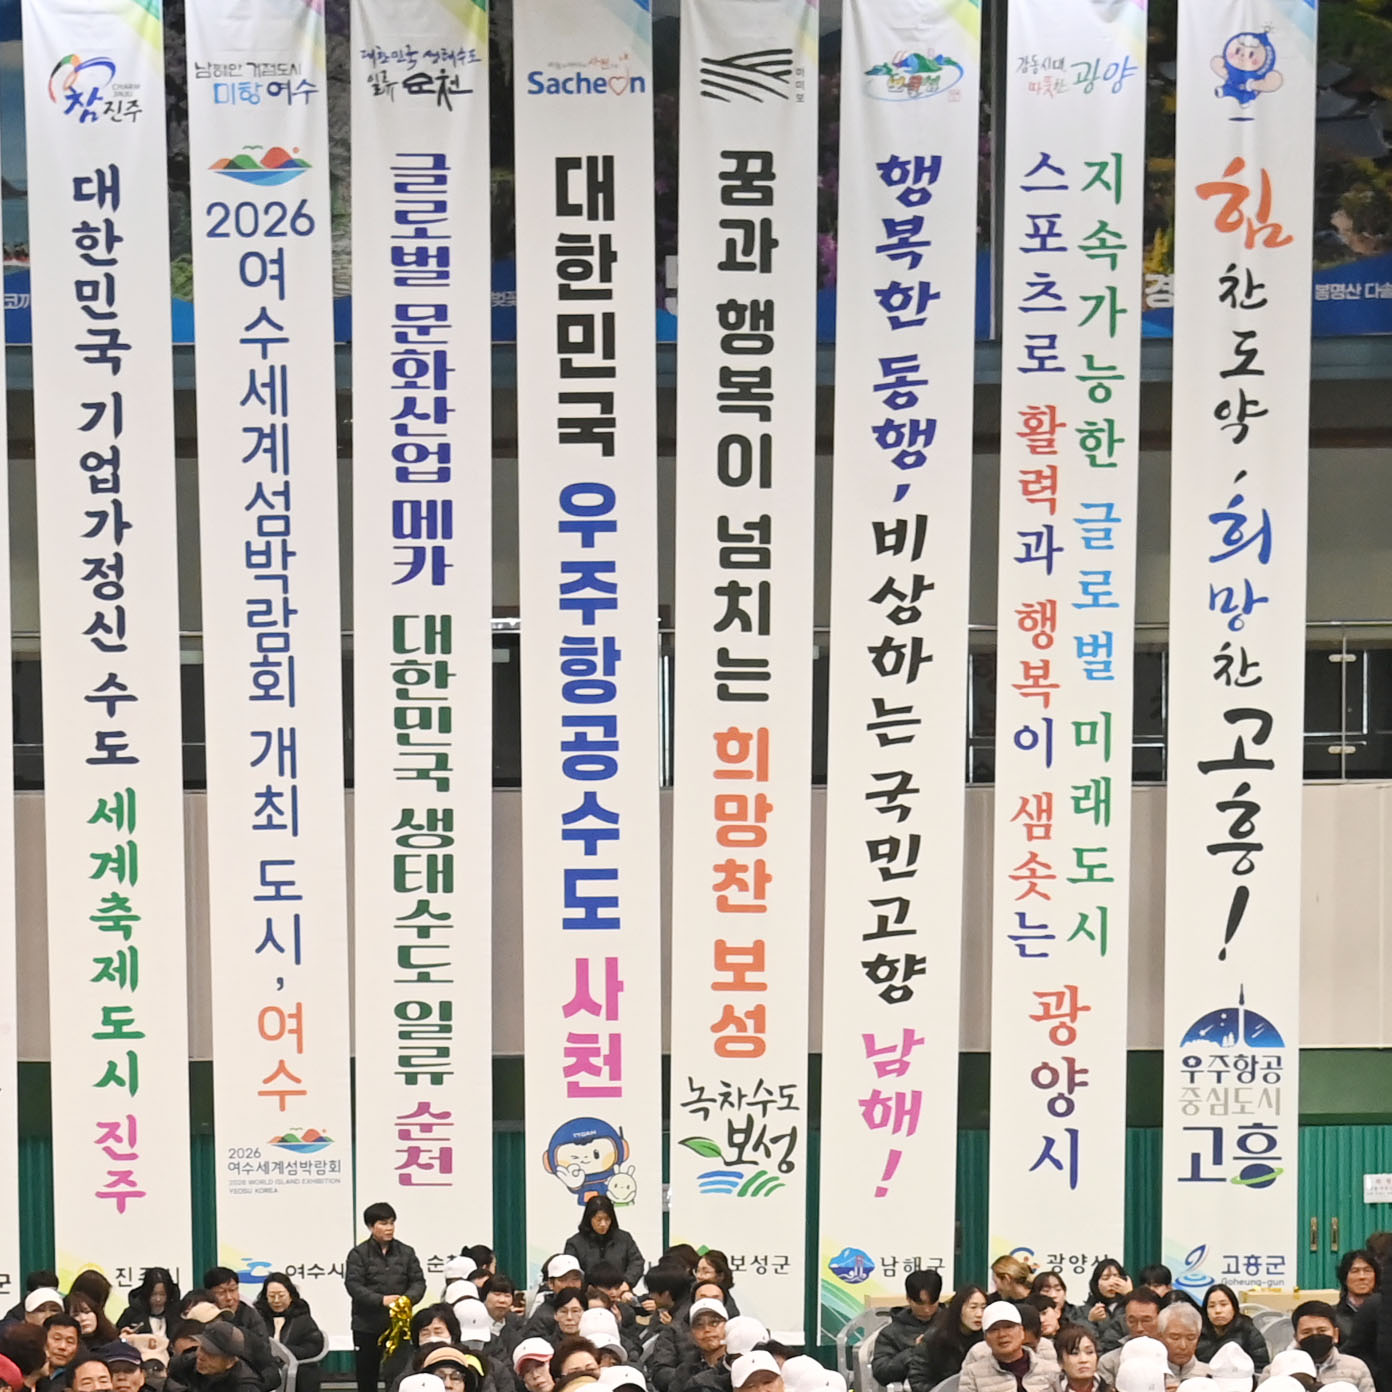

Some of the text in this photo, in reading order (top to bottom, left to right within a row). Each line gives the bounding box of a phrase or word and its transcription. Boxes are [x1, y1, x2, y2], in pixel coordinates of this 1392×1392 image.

[103, 99, 143, 123] 진주
[213, 79, 319, 106] 미항 여수
[402, 68, 474, 112] 순천
[1069, 55, 1139, 95] 광양
[205, 199, 316, 241] 2026
[390, 152, 452, 288] 글로벌
[874, 154, 943, 333] 행복한
[71, 162, 133, 377] 대한민국
[1073, 151, 1128, 470] 지속가능한
[1314, 282, 1361, 302] 봉명산
[390, 303, 457, 484] 문화산업
[78, 391, 133, 653] 기업가정신
[391, 499, 455, 586] 메카
[1006, 151, 1070, 959] 스포츠로 활력과 행복이 샘솟는
[554, 154, 625, 1099] 대한민국 우주항공수도 사천
[710, 149, 780, 1059] 꿈과 행복이 넘치는 희망찬 보성
[867, 513, 936, 749] 비상하는
[1070, 501, 1123, 682] 글로벌
[83, 671, 141, 765] 수도
[390, 614, 457, 793] 대한민국
[248, 726, 299, 838] 개최
[391, 807, 455, 984] 생태수도
[256, 1000, 309, 1113] 여수
[393, 1000, 455, 1086] 일류
[1027, 983, 1092, 1191] 광양시
[1179, 1053, 1284, 1086] 우주항공
[393, 1101, 456, 1187] 순천
[679, 1076, 802, 1122] 녹차수도
[722, 1112, 798, 1175] 보성
[1178, 1086, 1282, 1117] 중심도시
[93, 1113, 147, 1215] 진주
[227, 1160, 342, 1176] 여수세계섬박람회
[228, 1147, 262, 1159] 2026
[1177, 1122, 1284, 1189] 고흥
[730, 1254, 791, 1276] 보성군
[1221, 1254, 1285, 1277] 고흥군
